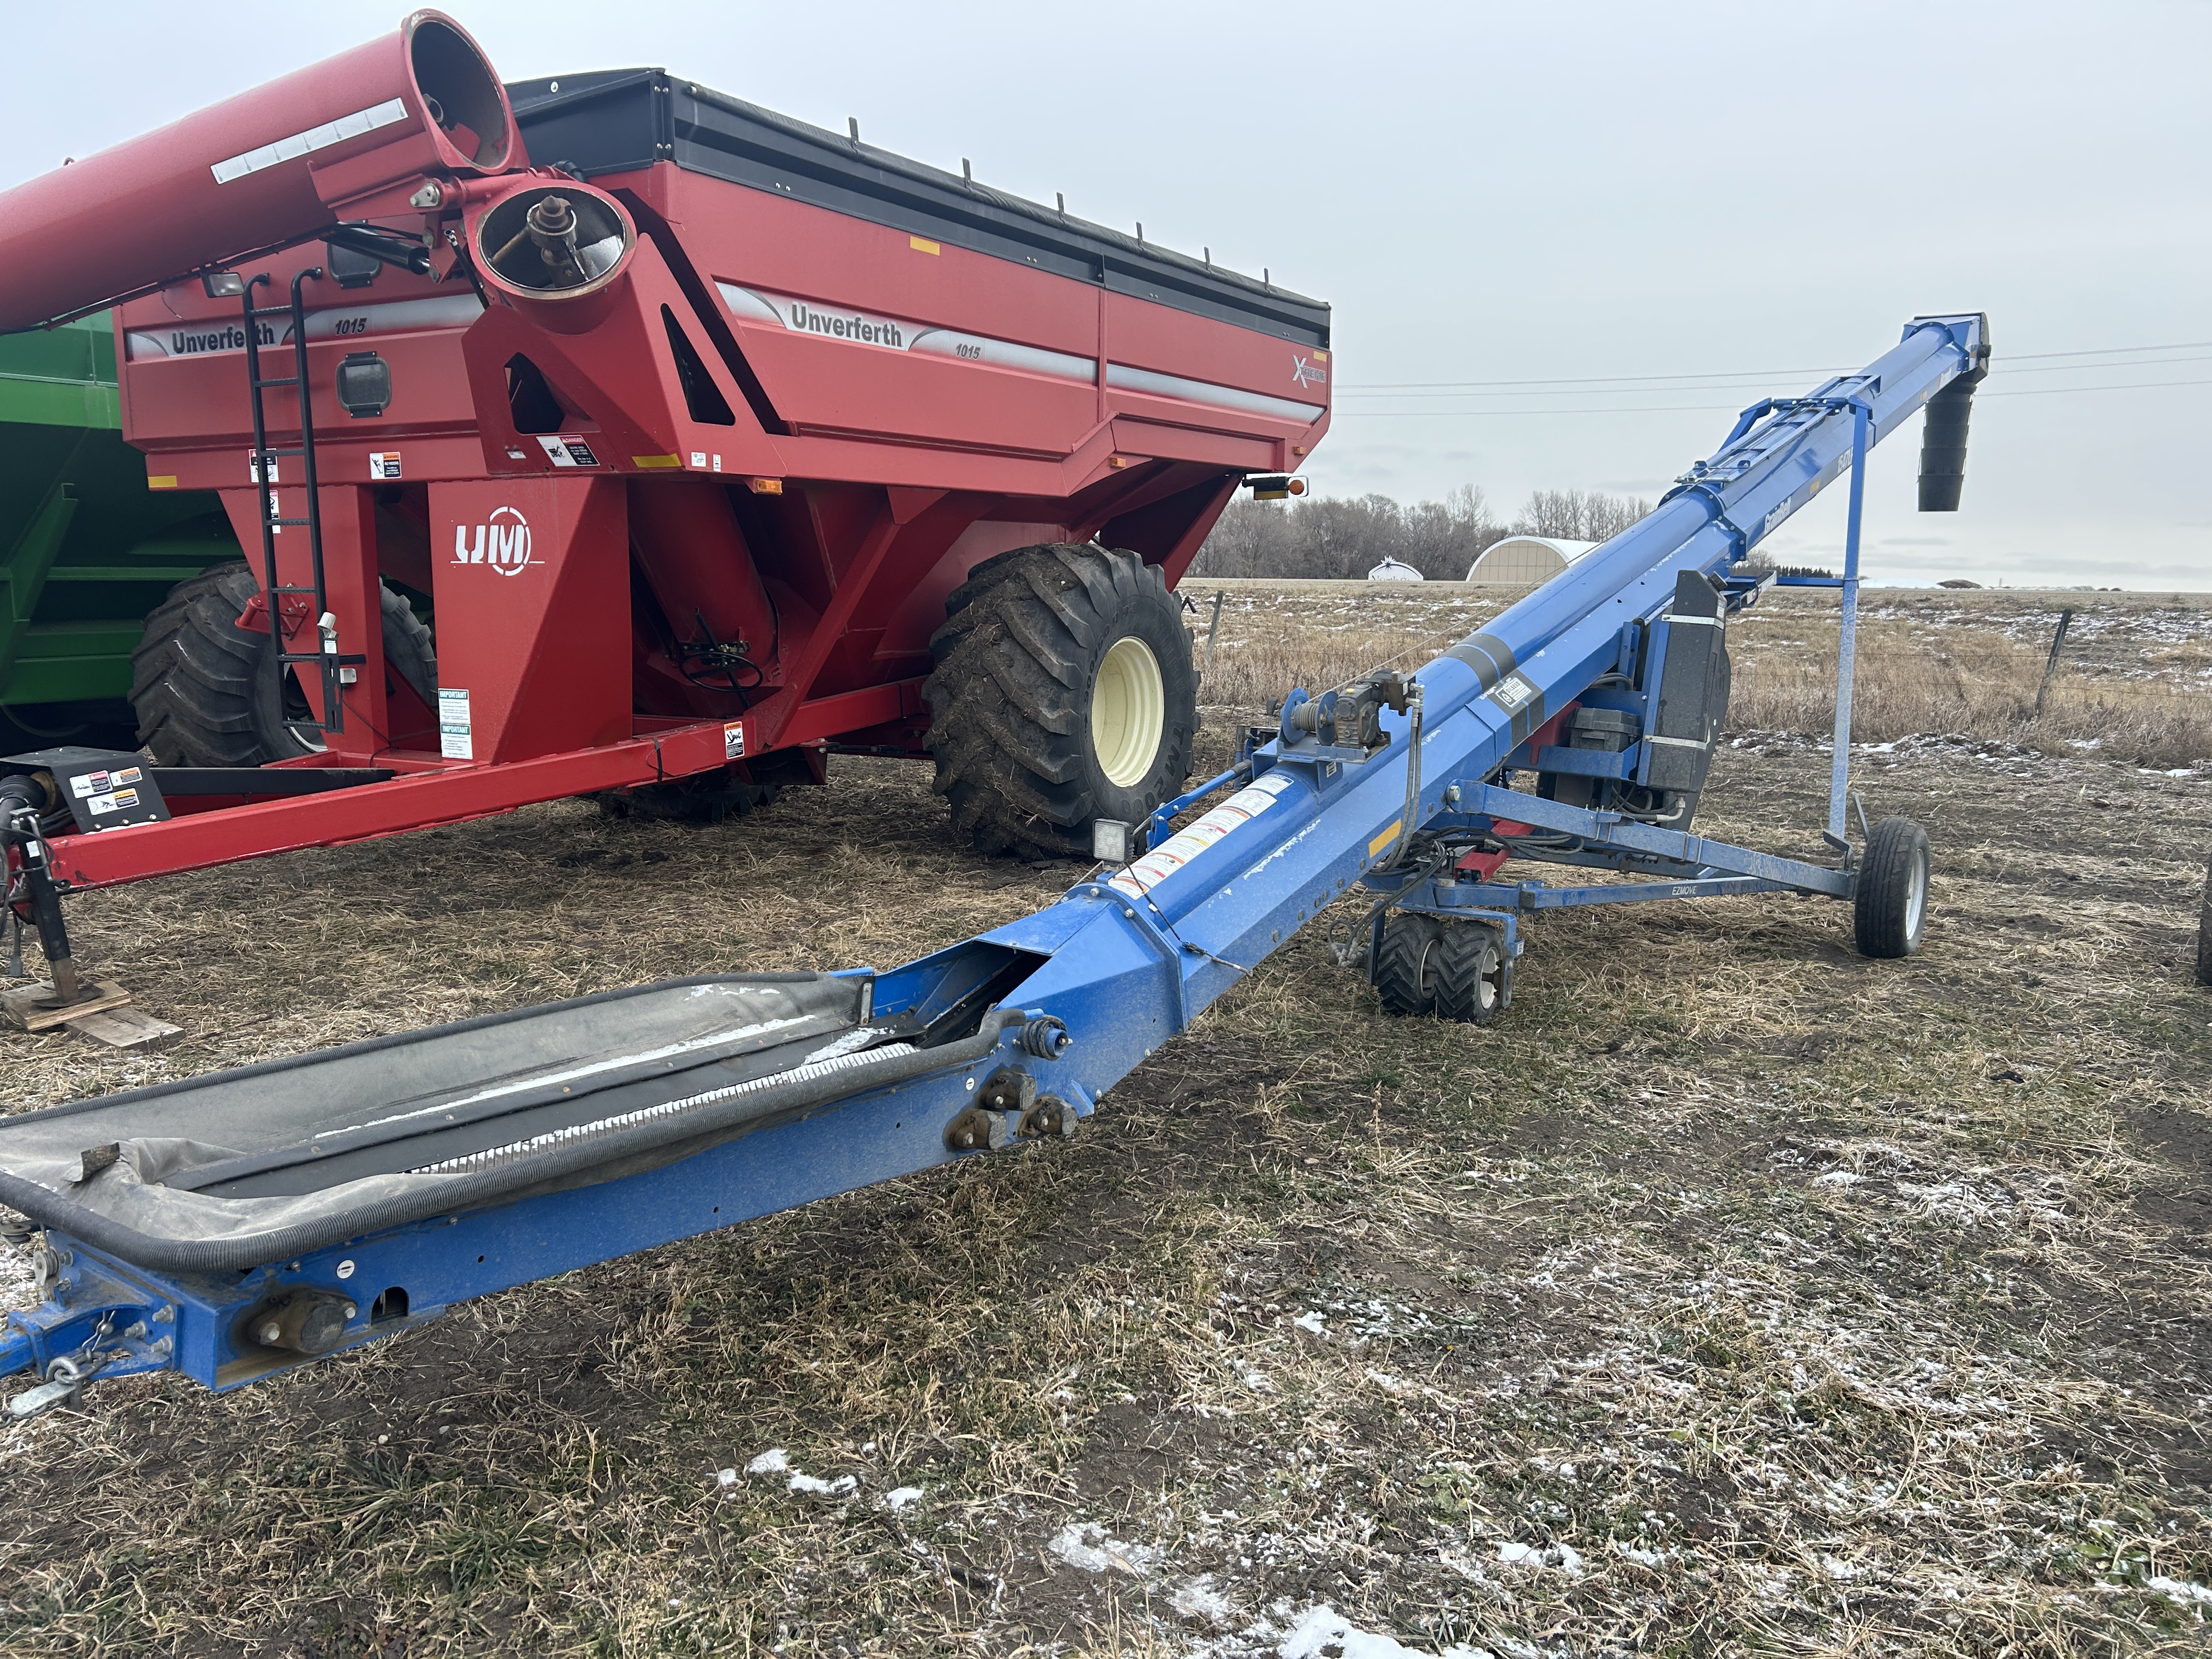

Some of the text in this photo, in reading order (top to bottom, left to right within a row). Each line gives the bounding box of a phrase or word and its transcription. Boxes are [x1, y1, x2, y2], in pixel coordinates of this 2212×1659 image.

[335, 317, 368, 335] 1015
[792, 303, 903, 348] Unverferth
[172, 323, 275, 354] Unverfeth
[955, 343, 981, 360] 1015
[439, 690, 467, 698] IMPORTANT
[442, 725, 469, 733] IMPORTANT
[1672, 885, 1698, 895] EZMOVE
